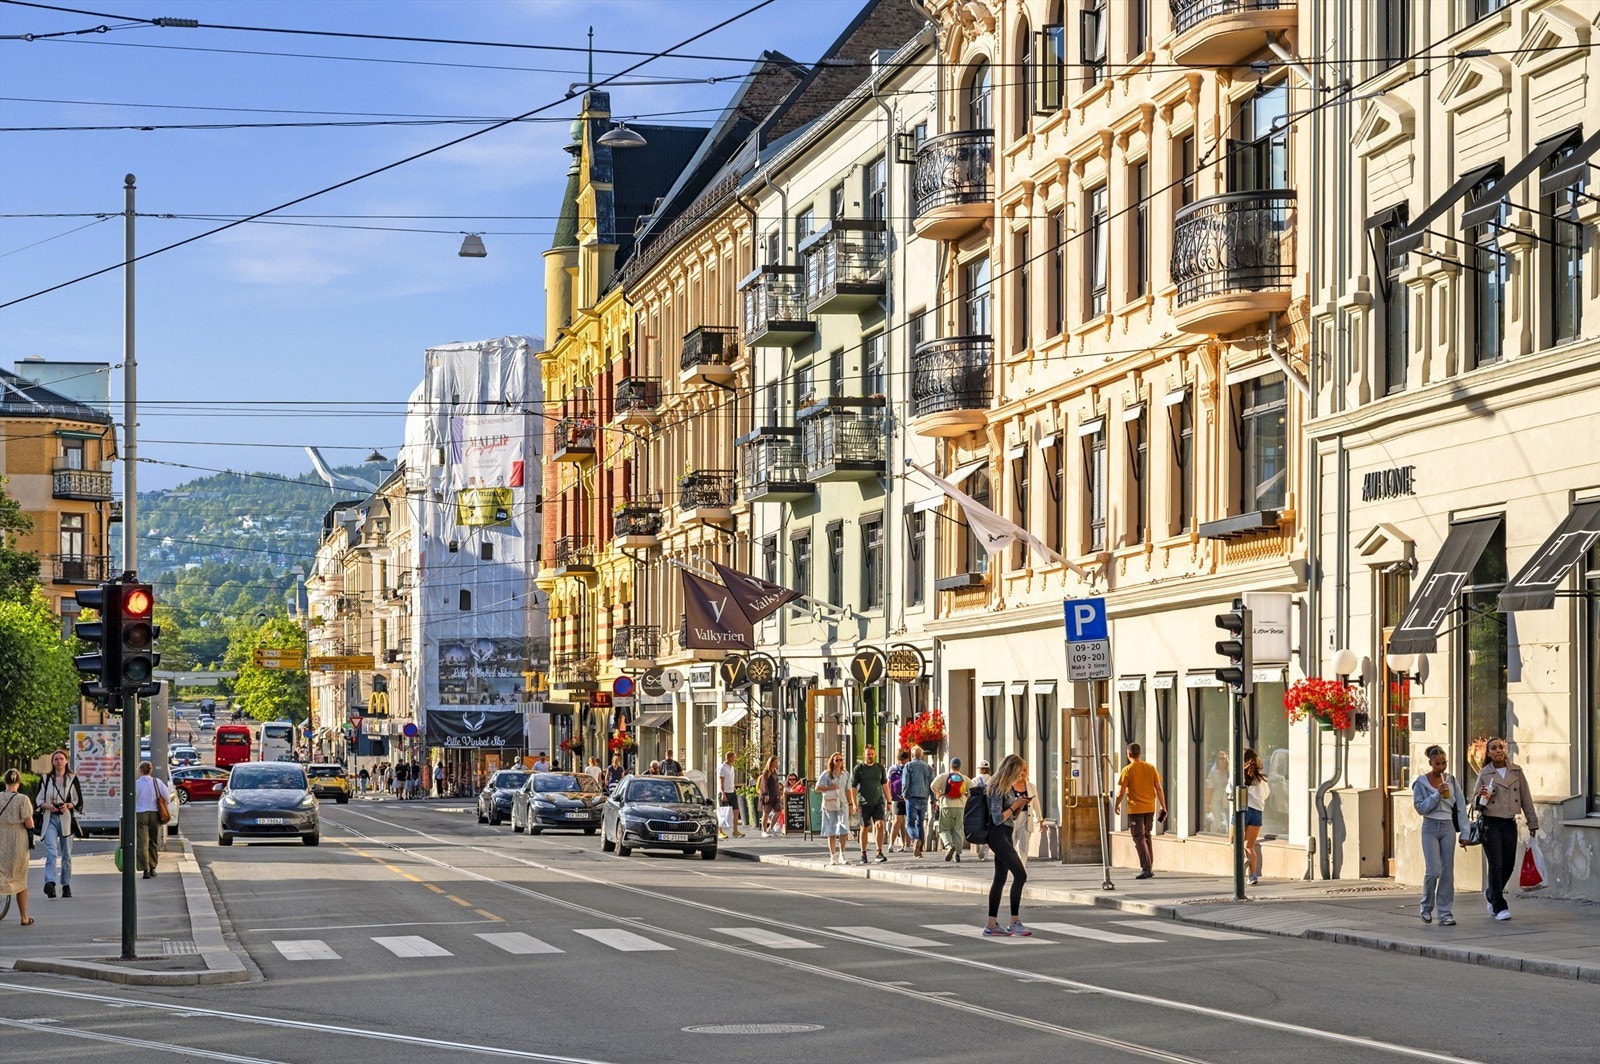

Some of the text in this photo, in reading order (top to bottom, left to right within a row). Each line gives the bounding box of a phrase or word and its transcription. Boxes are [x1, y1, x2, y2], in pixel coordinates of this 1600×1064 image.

[1074, 604, 1096, 637] P
[695, 628, 745, 643] Valkyrien
[444, 736, 506, 747] Lille Vinkel Sko
